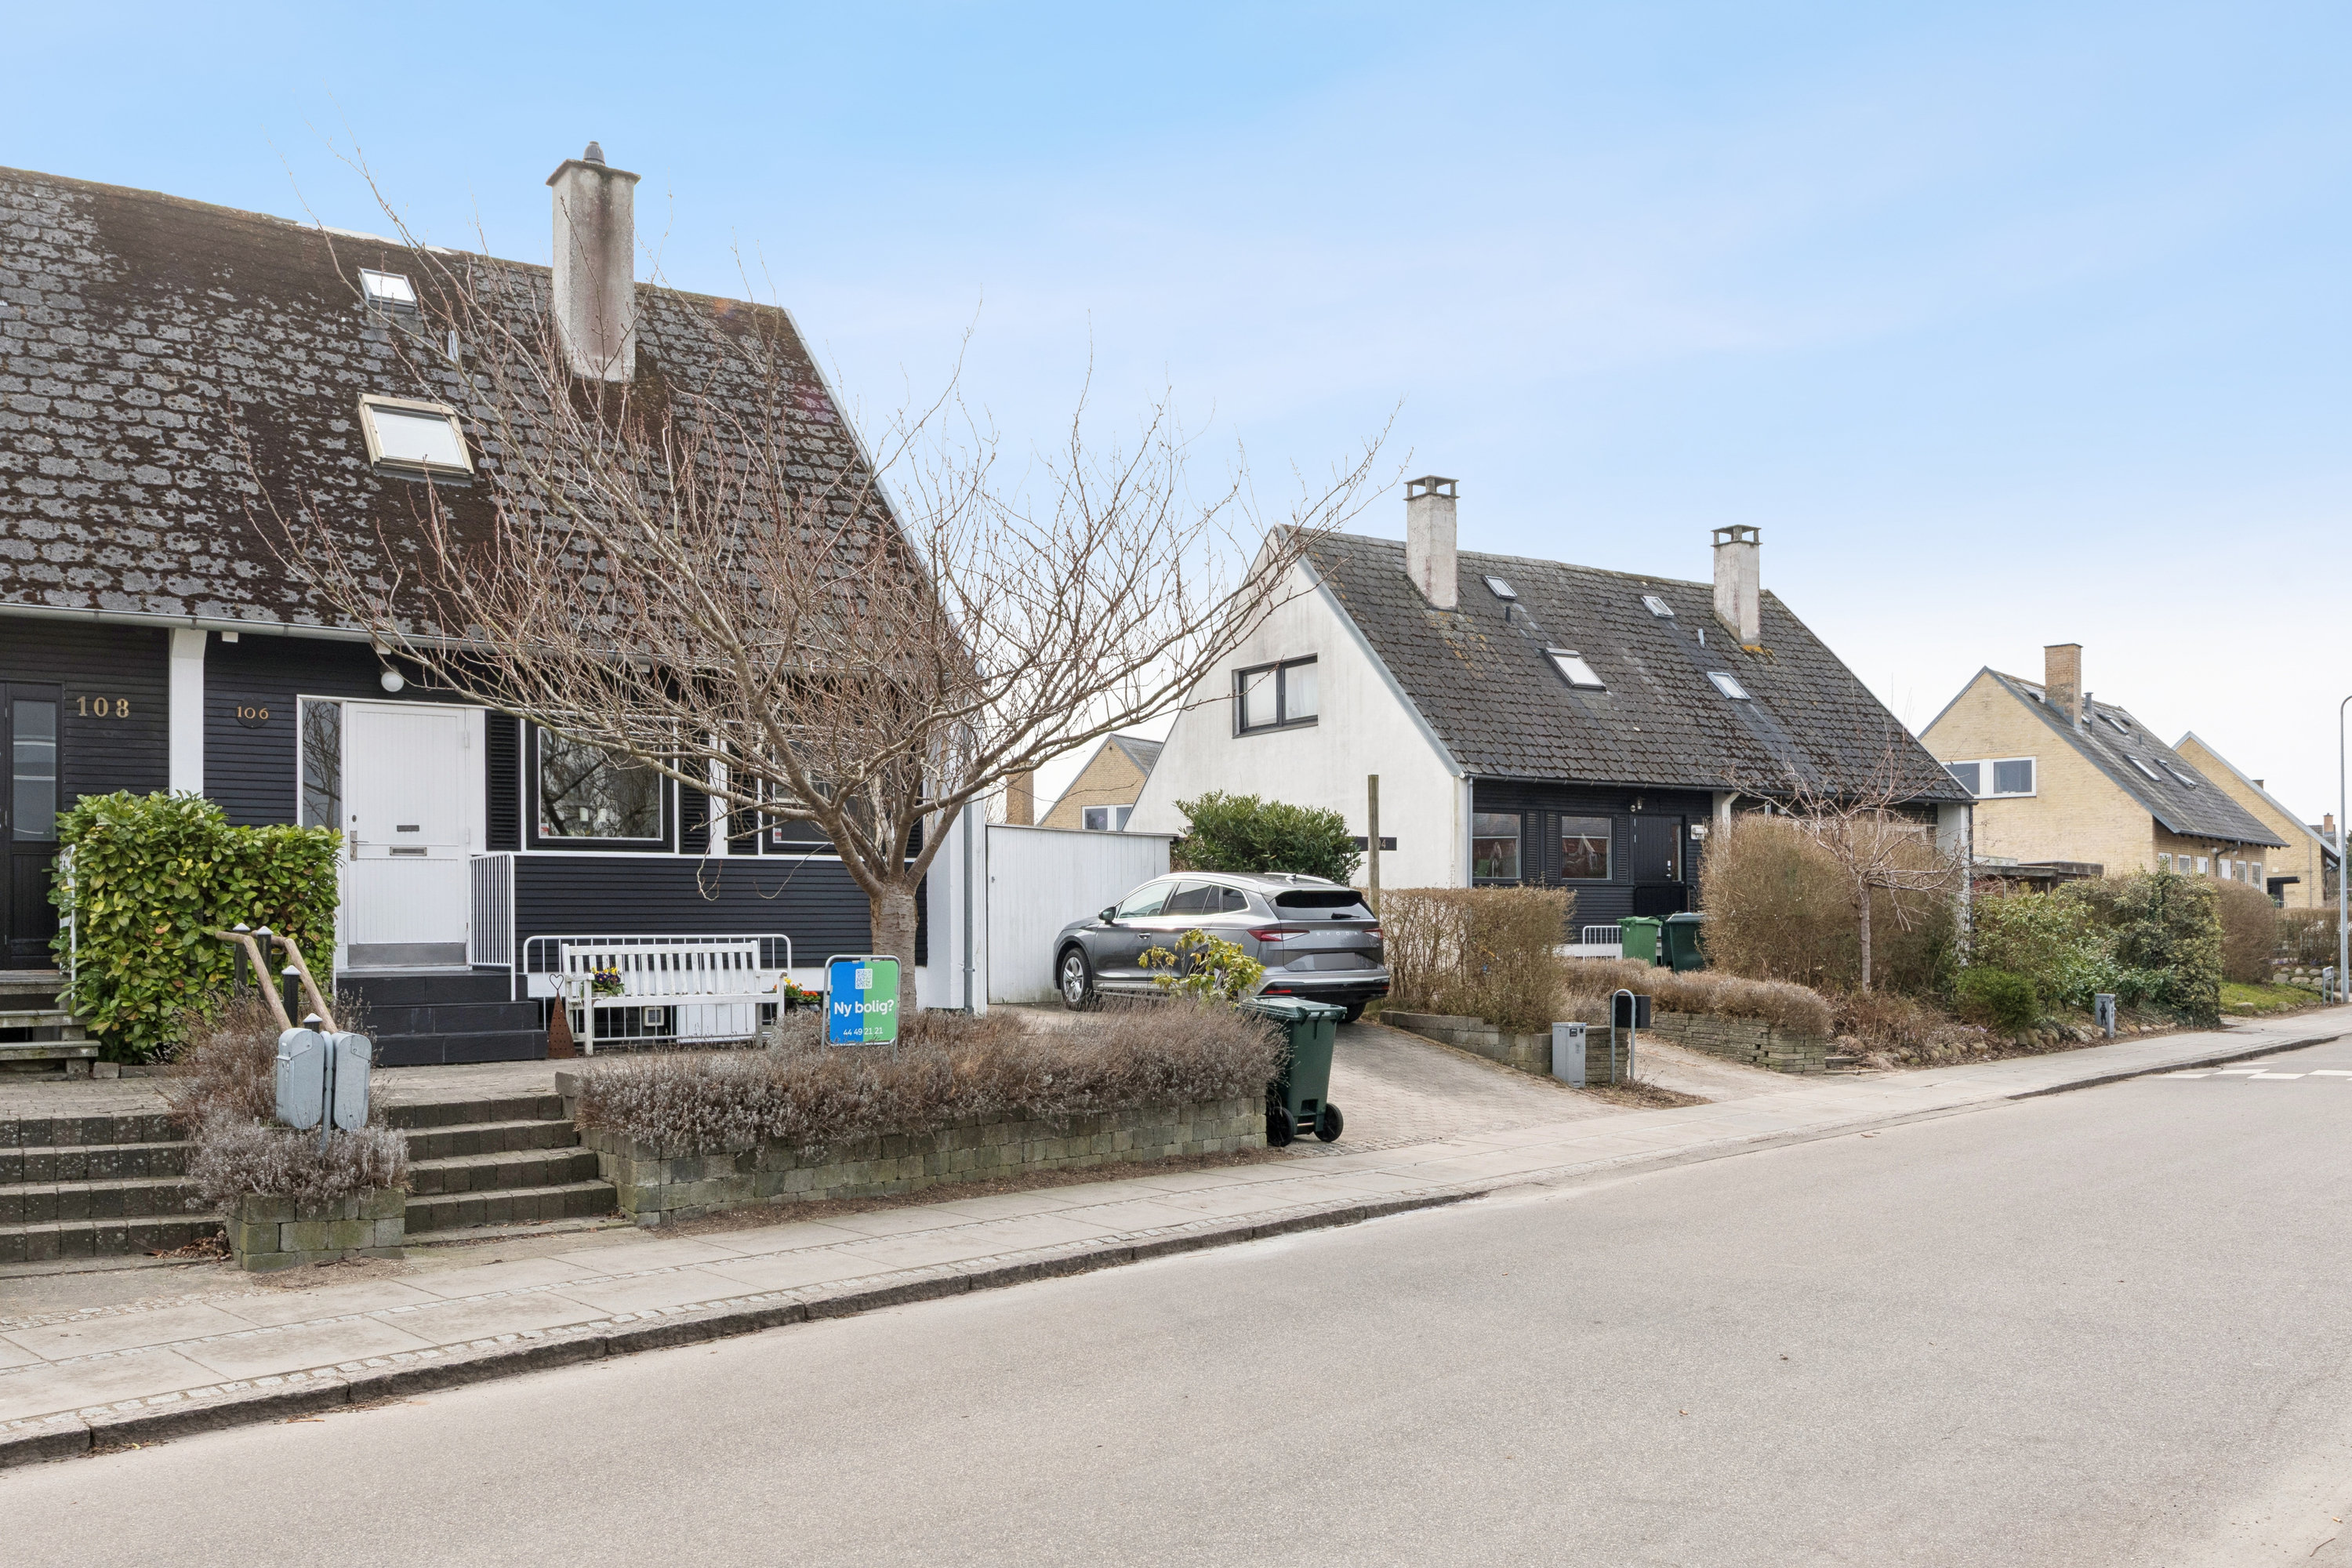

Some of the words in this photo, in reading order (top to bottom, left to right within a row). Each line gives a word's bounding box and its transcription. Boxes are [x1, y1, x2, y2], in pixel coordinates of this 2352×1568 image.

[76, 695, 129, 718] 108
[237, 706, 269, 720] 106
[833, 1001, 852, 1018] Ny
[855, 999, 895, 1015] bolig?
